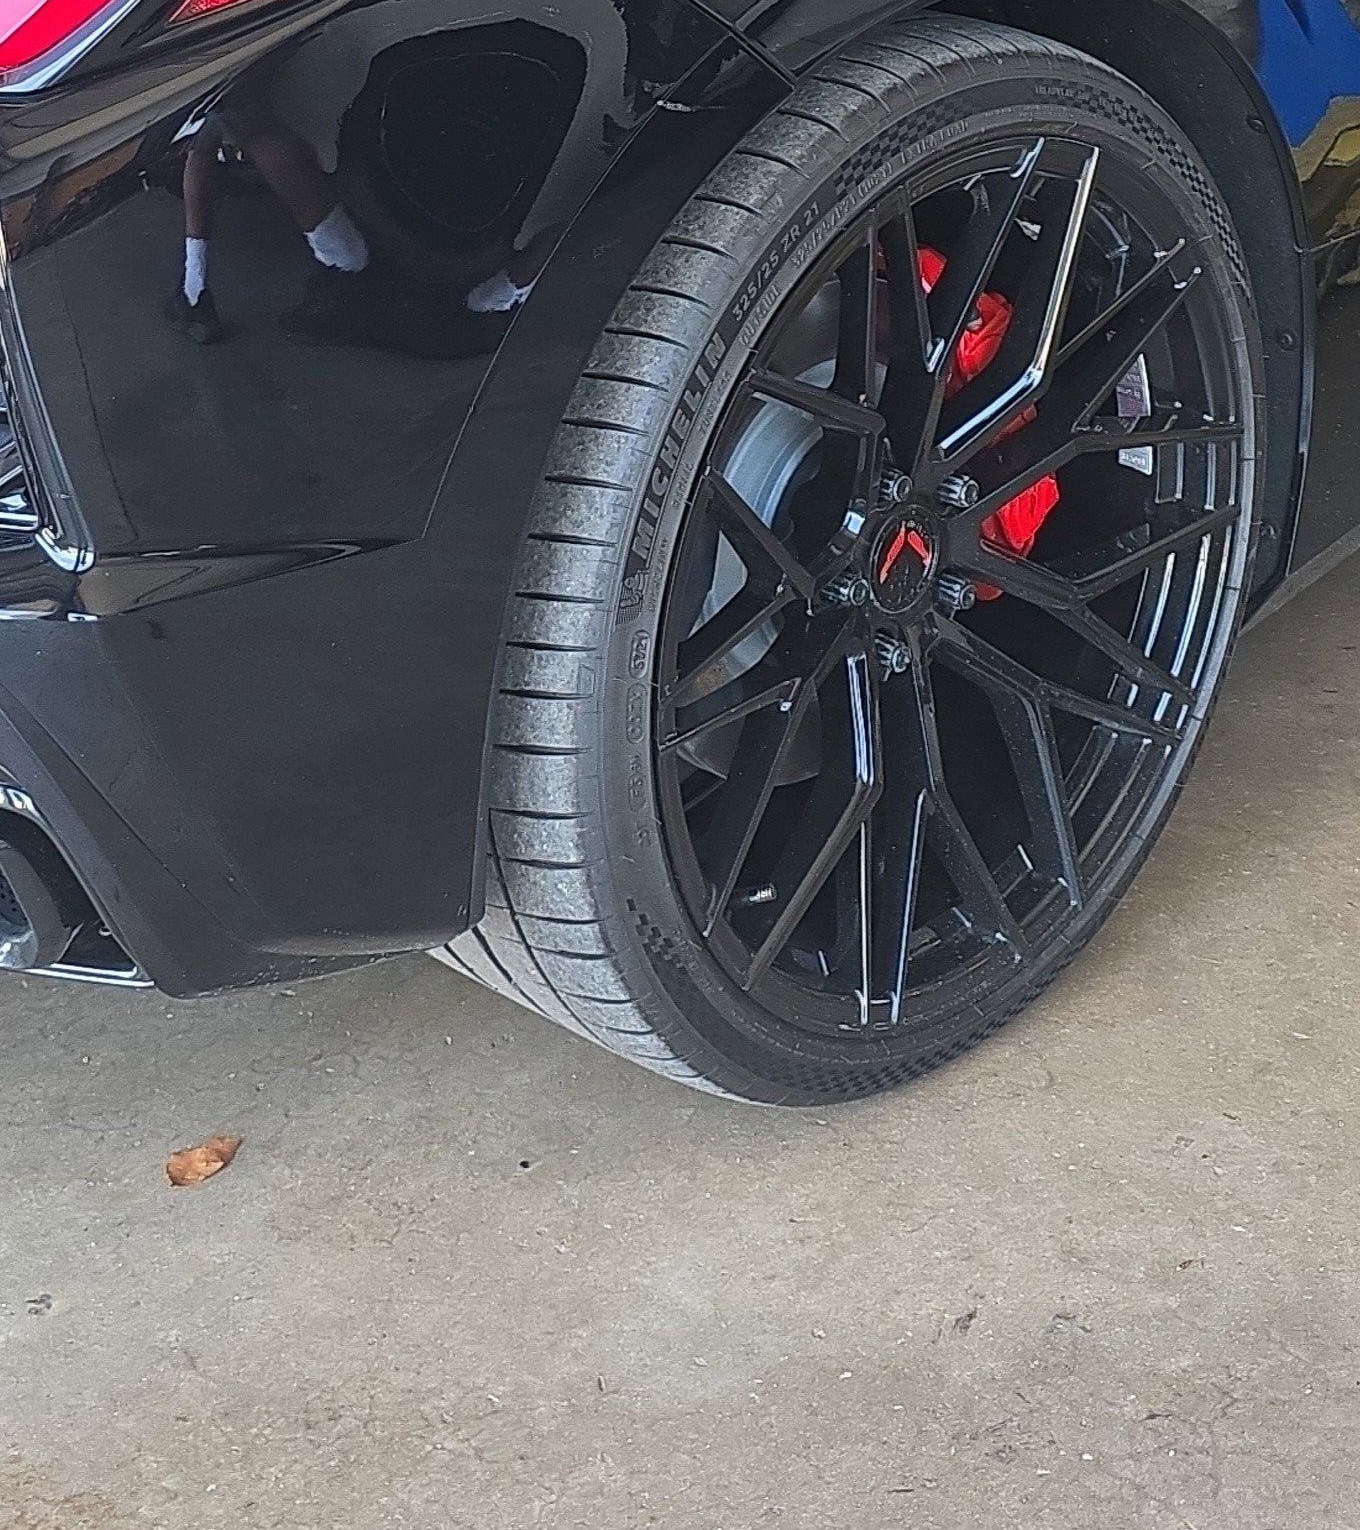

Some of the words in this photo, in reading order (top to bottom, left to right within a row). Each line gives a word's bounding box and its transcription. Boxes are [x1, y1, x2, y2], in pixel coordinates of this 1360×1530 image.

[632, 331, 727, 562] MICHELIN
[731, 250, 781, 322] 325/25
[780, 224, 802, 253] ZR
[802, 201, 820, 227] 21
